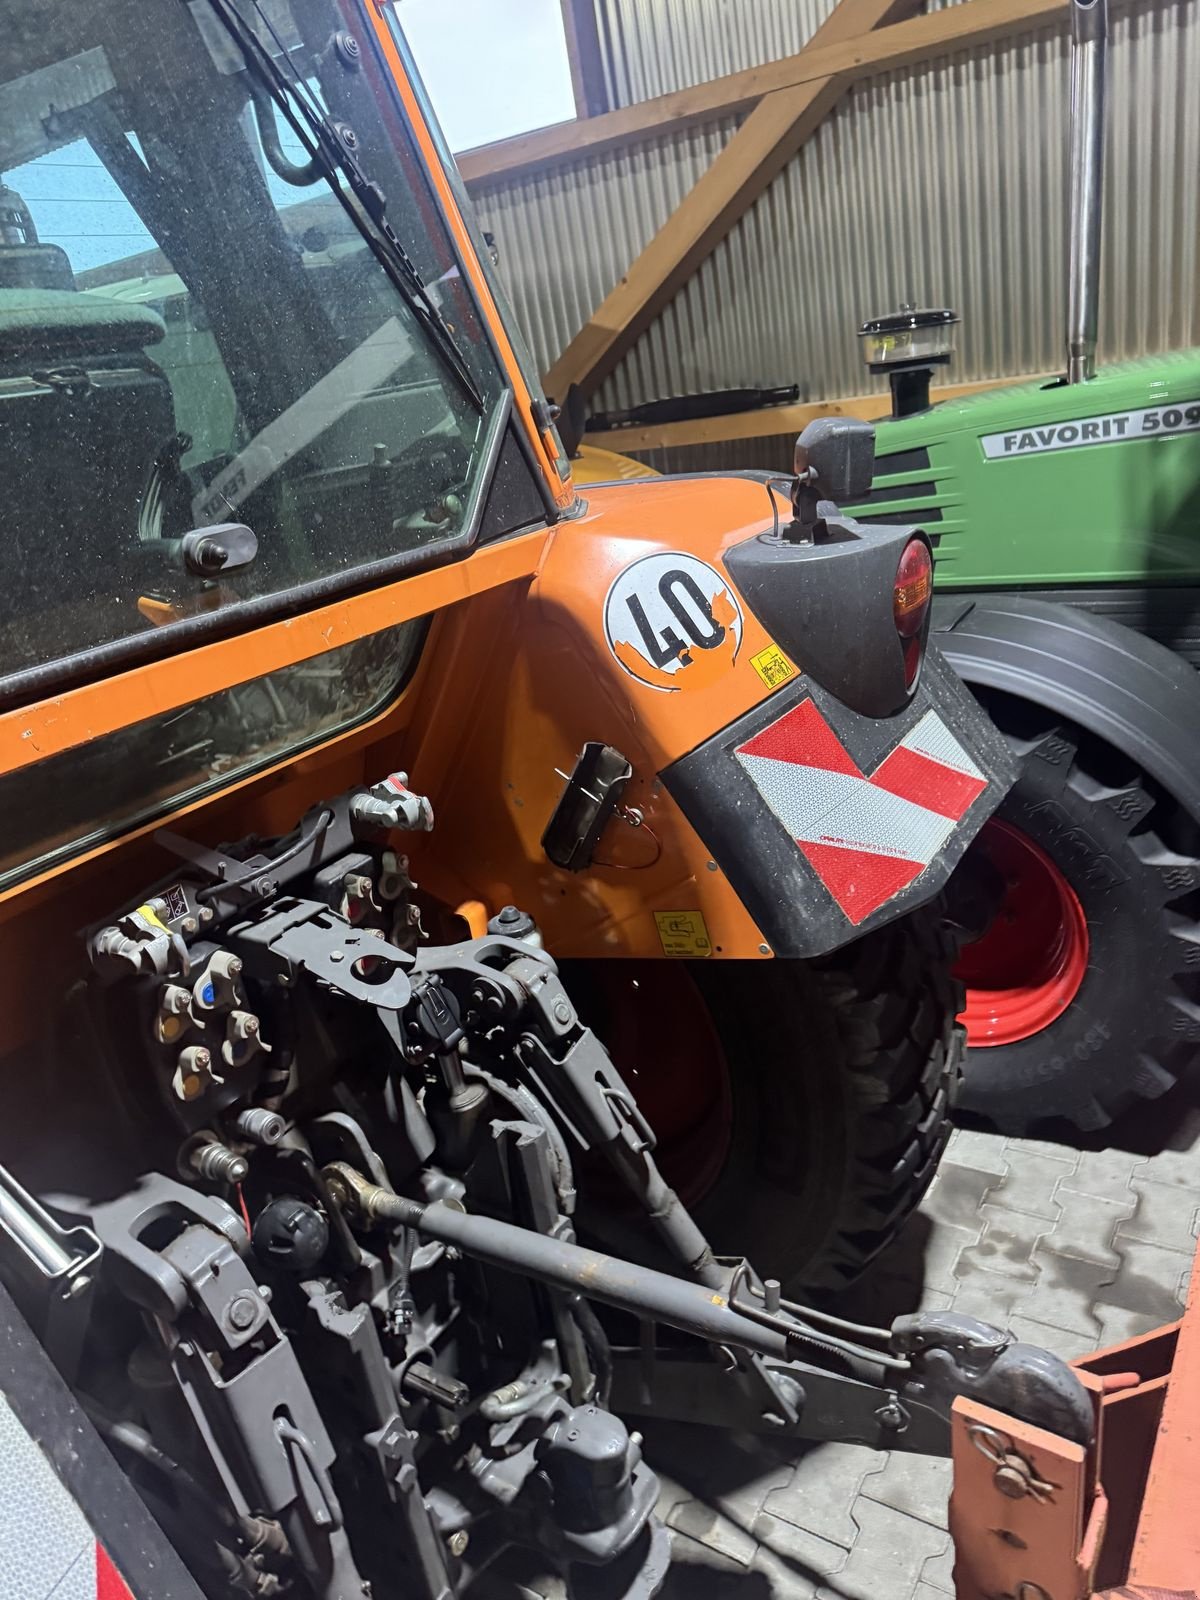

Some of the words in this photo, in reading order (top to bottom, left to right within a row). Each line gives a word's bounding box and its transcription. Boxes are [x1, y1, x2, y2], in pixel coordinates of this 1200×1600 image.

[1004, 416, 1130, 452] FAVORIT
[1142, 405, 1200, 431] 509
[625, 569, 726, 669] 40
